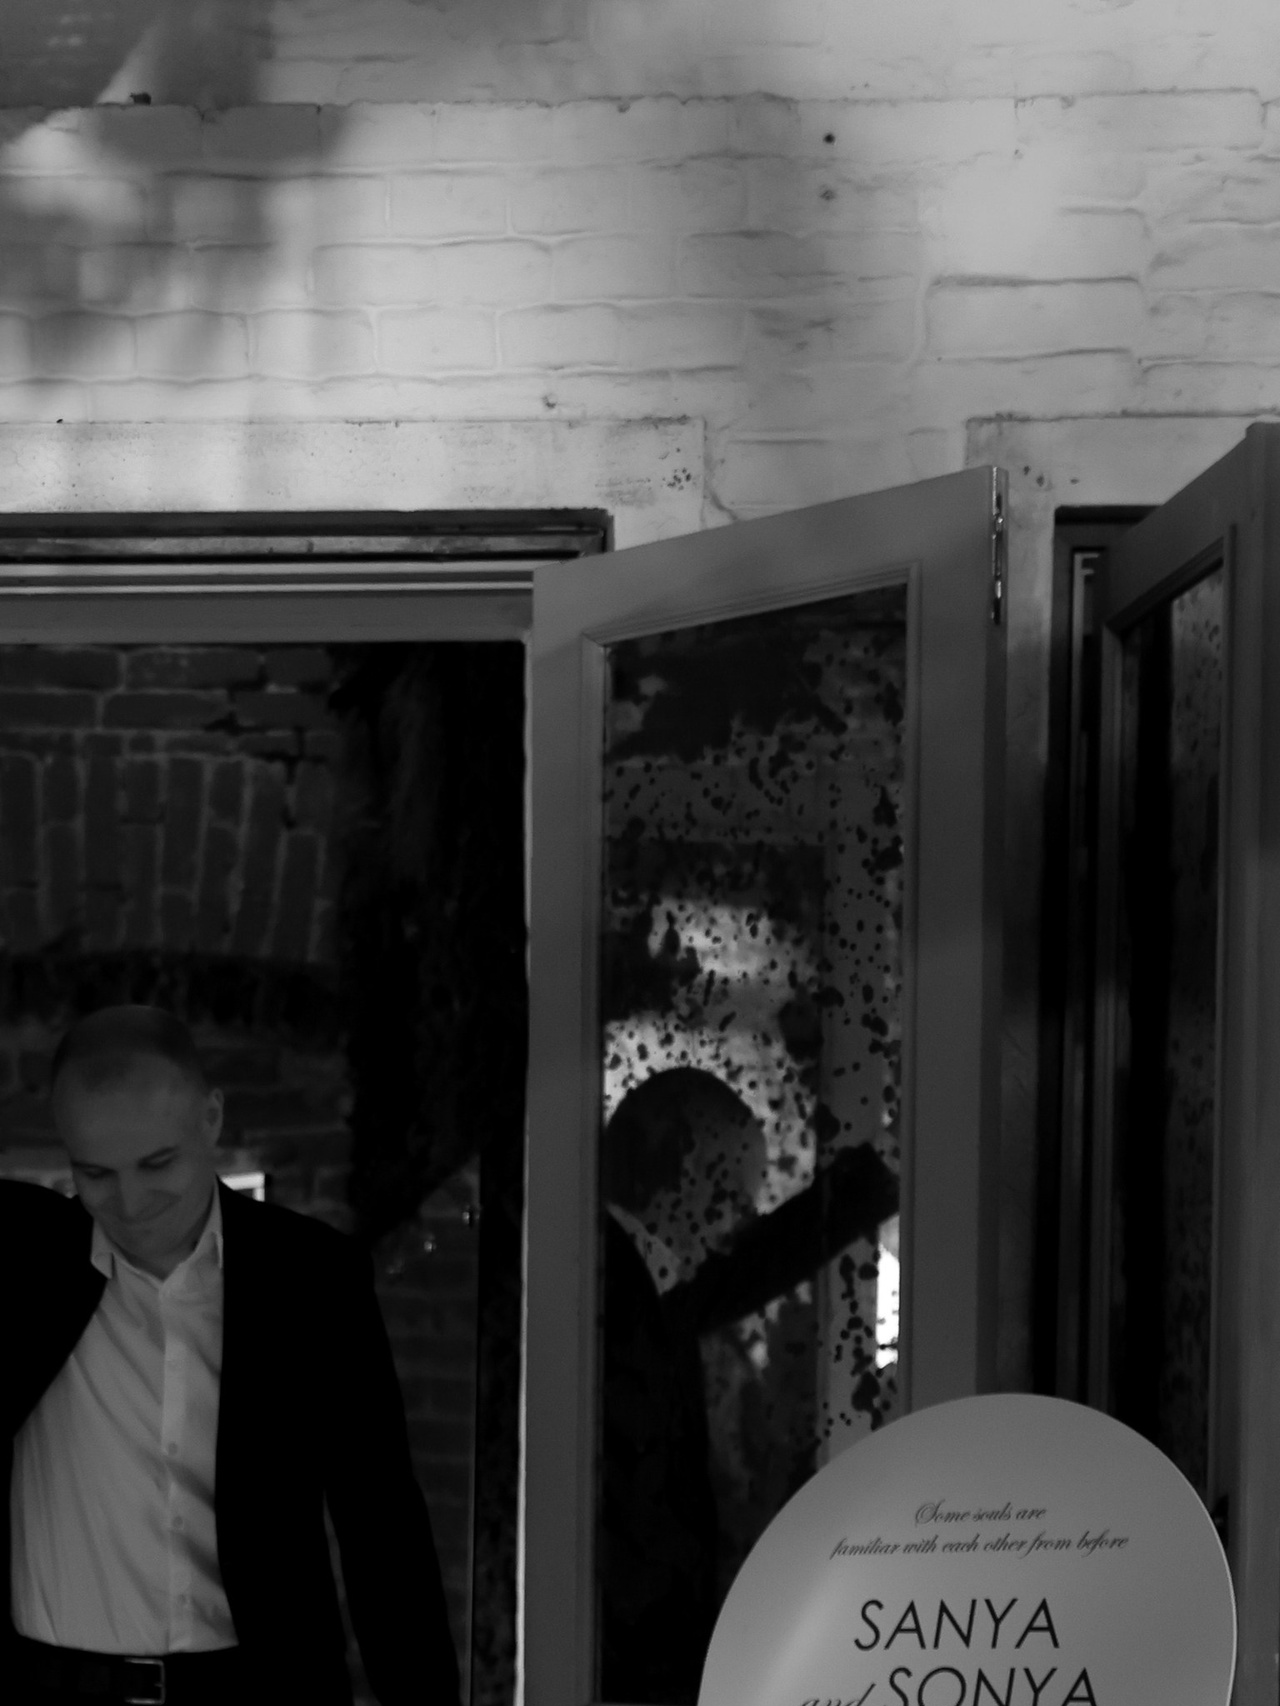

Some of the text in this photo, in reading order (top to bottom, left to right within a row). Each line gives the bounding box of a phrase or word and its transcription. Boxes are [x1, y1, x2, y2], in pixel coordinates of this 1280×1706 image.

[914, 1499, 1047, 1527] Some souls are
[829, 1528, 1129, 1560] familiar with each other from before
[854, 1598, 1060, 1651] SANYA
